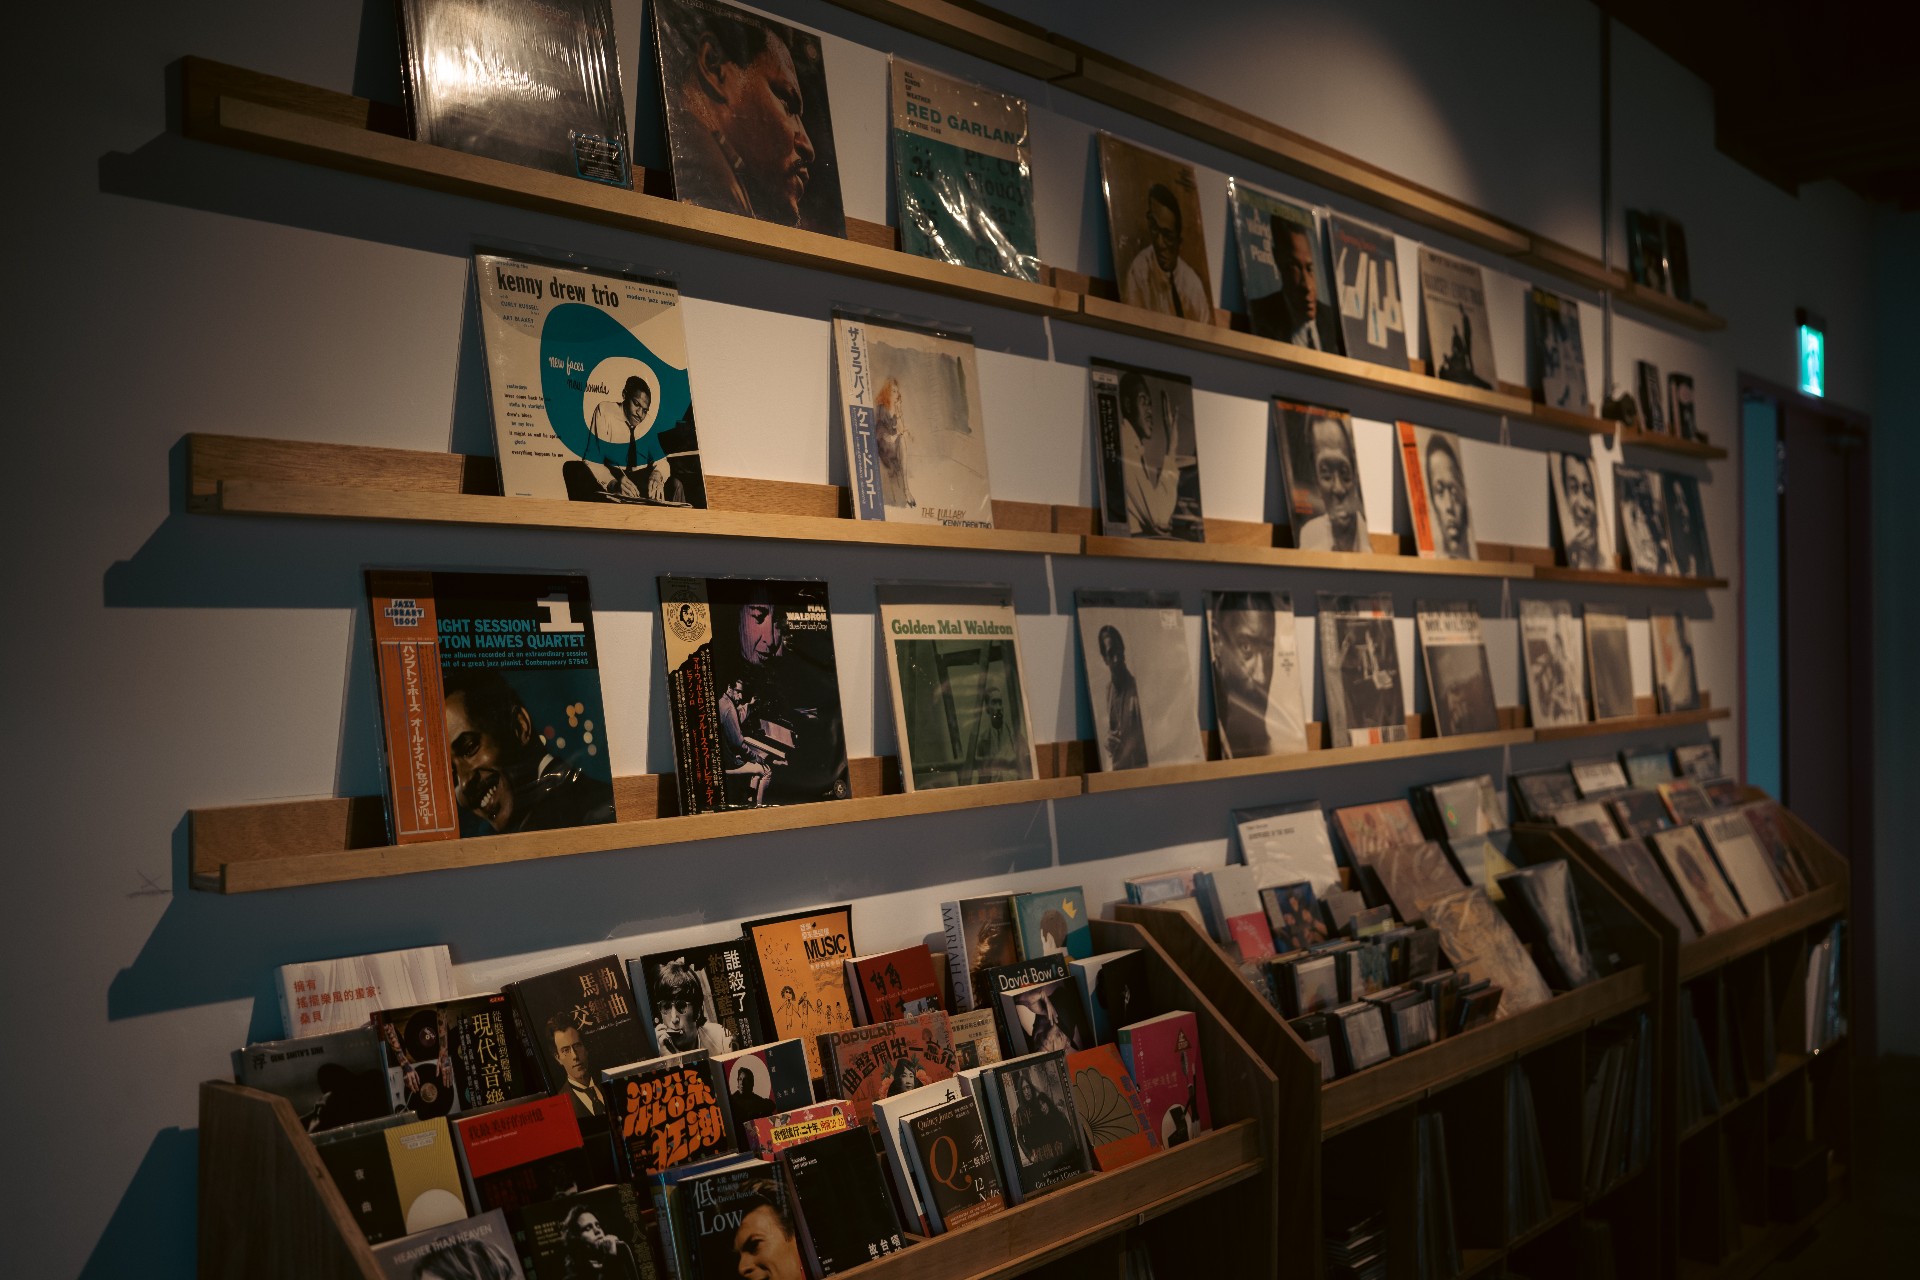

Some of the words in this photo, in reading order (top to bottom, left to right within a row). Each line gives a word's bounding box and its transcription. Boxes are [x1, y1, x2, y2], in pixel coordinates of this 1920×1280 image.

[904, 71, 914, 79] ALL
[904, 77, 921, 88] KINDS
[905, 92, 932, 104] WEATHER
[906, 102, 942, 124] RED
[496, 267, 543, 299] kenny
[550, 276, 586, 303] drew
[592, 283, 619, 308] trio
[548, 356, 565, 370] new
[566, 355, 584, 376] faces
[848, 327, 864, 404] ザ・ララバイ
[566, 378, 583, 392] new
[922, 508, 935, 518] THE
[937, 508, 967, 521] LULLABY
[385, 608, 423, 617] LIBRARY
[393, 600, 415, 608] JAZZ
[475, 619, 538, 633] SESSION!
[536, 593, 585, 632] 1
[807, 604, 827, 612] MAL
[892, 619, 937, 635] Golden
[937, 620, 963, 635] Mal
[964, 619, 1013, 635] Waldron
[475, 634, 523, 648] HAWES
[526, 634, 586, 649] QUARTET
[467, 660, 485, 669] great
[486, 660, 499, 668] jazz
[525, 659, 567, 668] Contemporary
[525, 651, 565, 659] extraordinary
[803, 933, 847, 960] MUSIC
[942, 908, 962, 975] MARIAH
[294, 979, 316, 993] 擁有
[723, 949, 746, 1013] 誰殺了
[998, 968, 1030, 991] David
[1030, 964, 1065, 983] Bowie
[300, 1010, 322, 1025] 桑貝
[569, 993, 629, 1031] 交響曲
[471, 1012, 505, 1104] 現代音樂
[917, 1116, 938, 1130] Quincy
[939, 1110, 954, 1123] Jones
[930, 1135, 972, 1191] Q
[693, 1179, 717, 1209] 低
[975, 1177, 985, 1192] 12
[697, 1209, 743, 1236] Low
[393, 1245, 432, 1265] HEAVIER
[431, 1236, 457, 1250] THAN
[457, 1224, 493, 1244] HEAVEN
